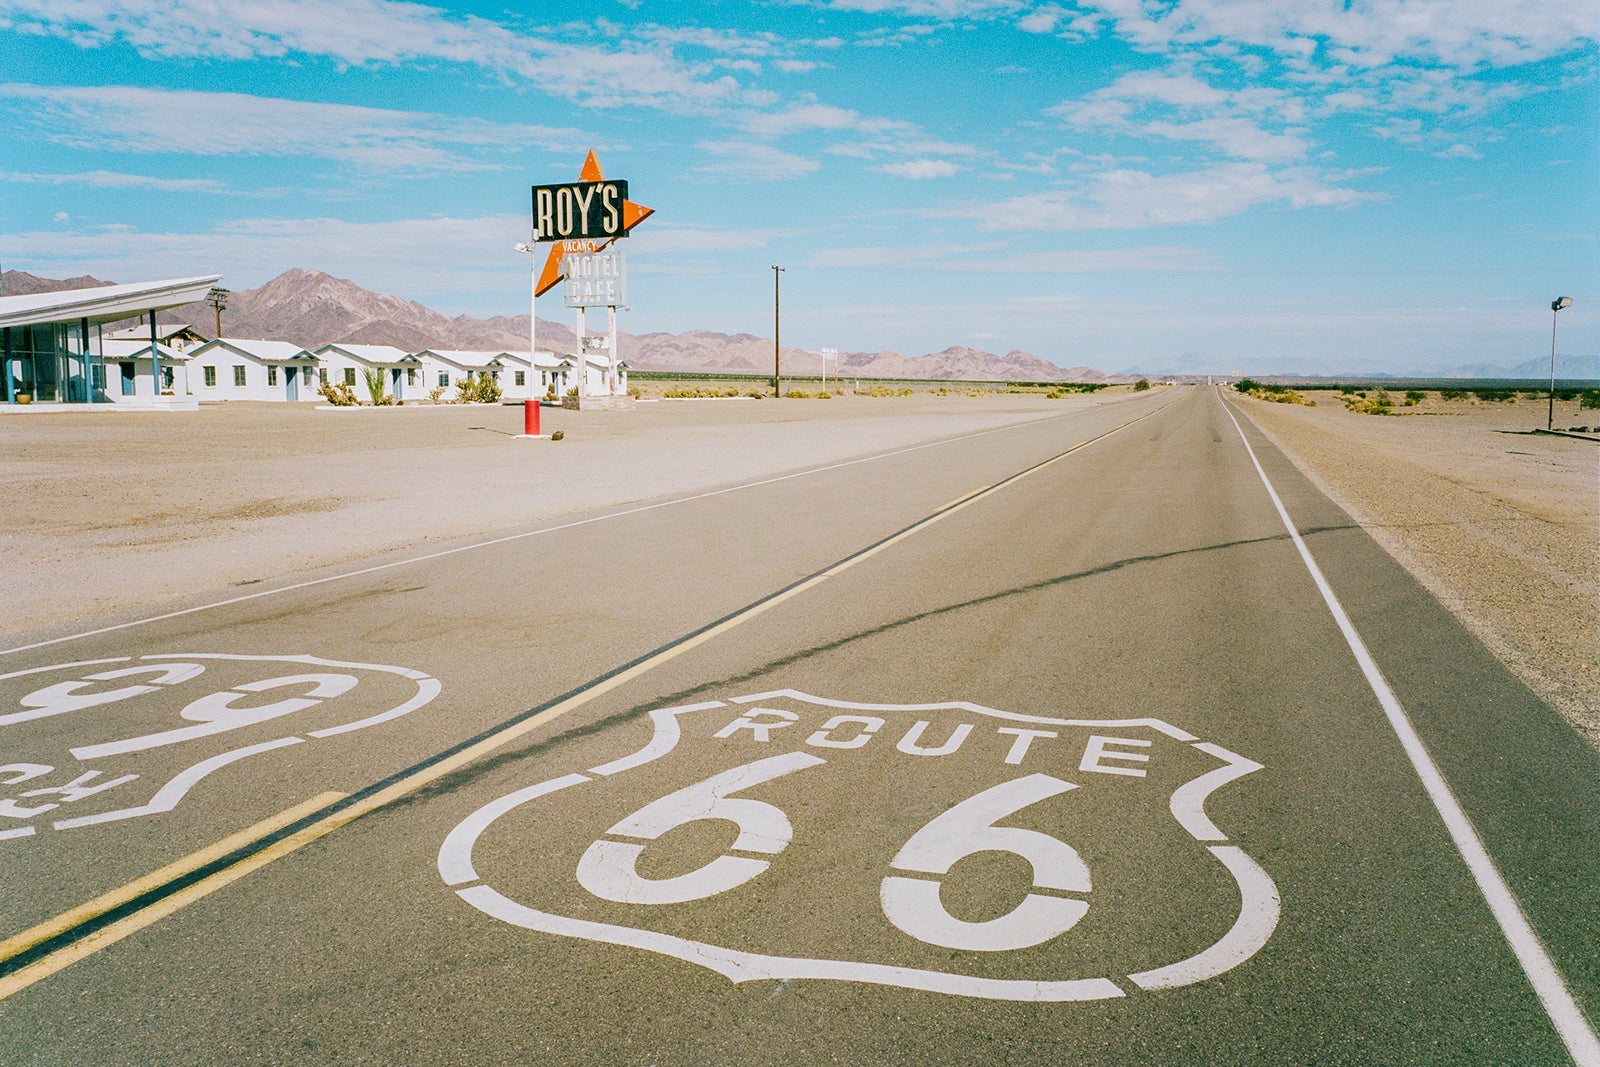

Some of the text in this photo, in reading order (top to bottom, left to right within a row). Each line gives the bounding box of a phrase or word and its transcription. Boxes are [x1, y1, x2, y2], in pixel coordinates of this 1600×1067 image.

[537, 182, 619, 237] ROY'S
[562, 240, 597, 253] VACANCY
[567, 255, 620, 279] MOTEL
[572, 281, 616, 304] CAFE
[714, 707, 1152, 778] ROUTE
[577, 752, 1092, 952] 66
